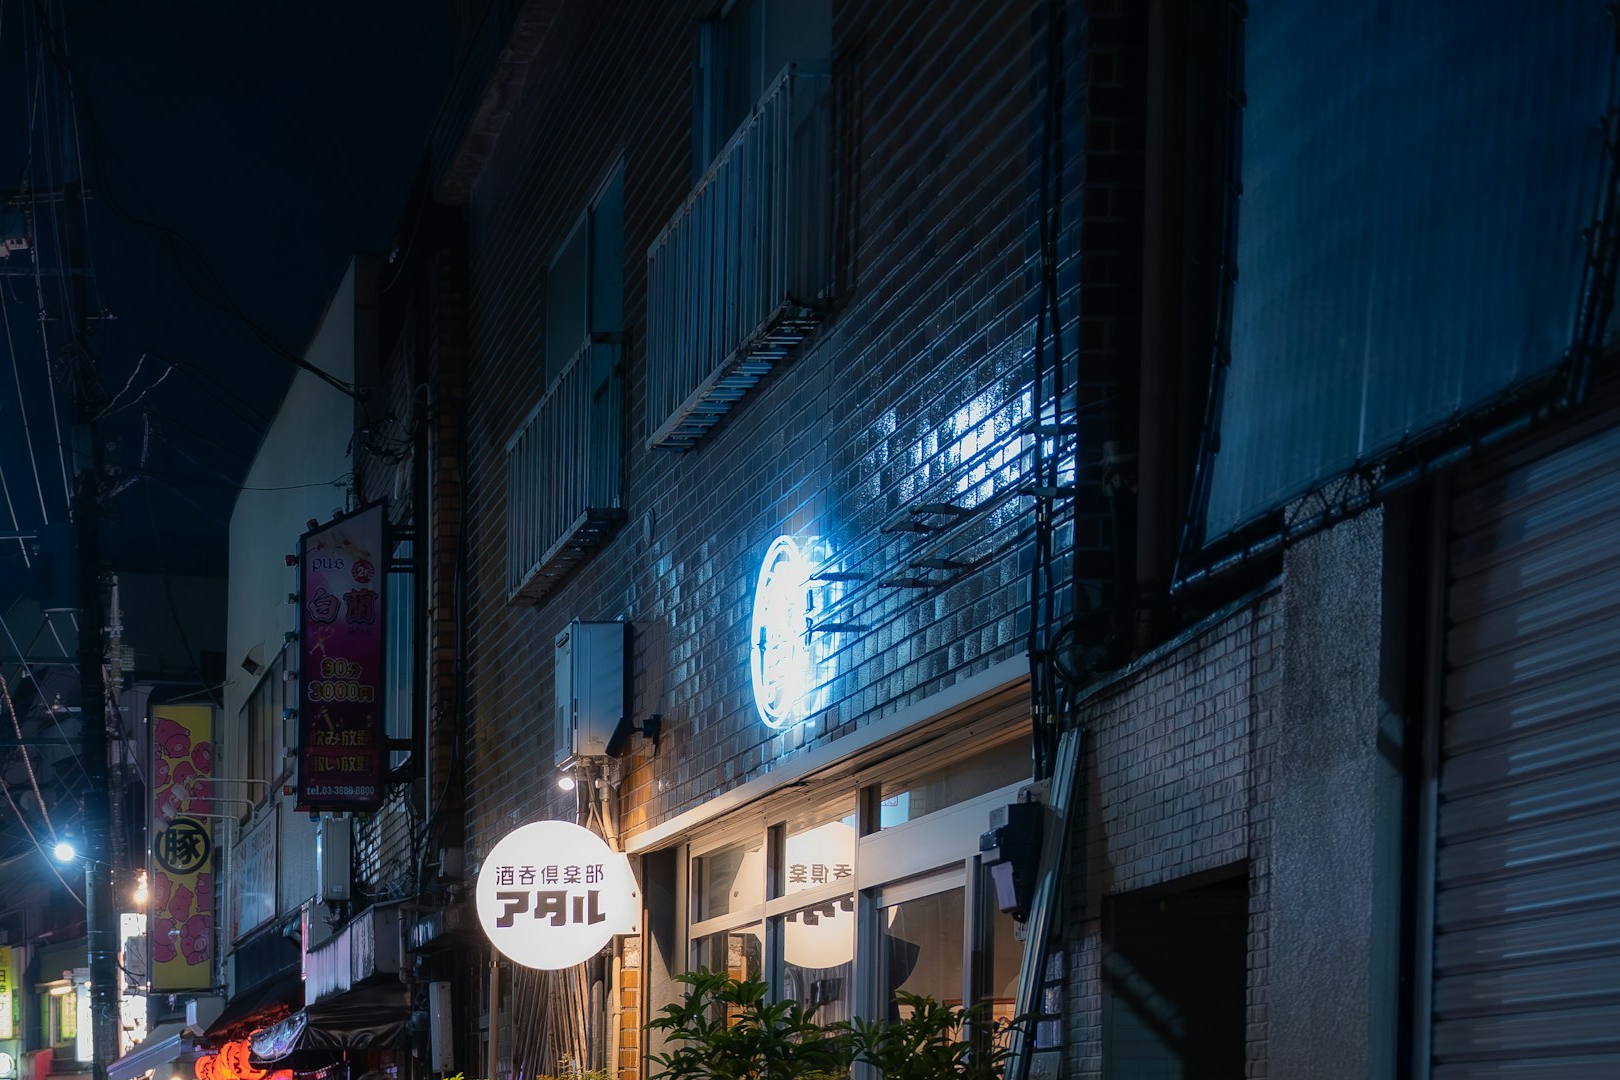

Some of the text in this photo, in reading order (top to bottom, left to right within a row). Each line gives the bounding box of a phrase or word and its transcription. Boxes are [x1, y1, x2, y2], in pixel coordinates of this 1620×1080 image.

[307, 587, 379, 625] 白蘭
[320, 657, 363, 680] 90分
[308, 680, 375, 703] 3000円
[165, 829, 202, 865] 豚
[495, 863, 605, 888] 酒呑倶楽部
[495, 889, 607, 928] アタル
